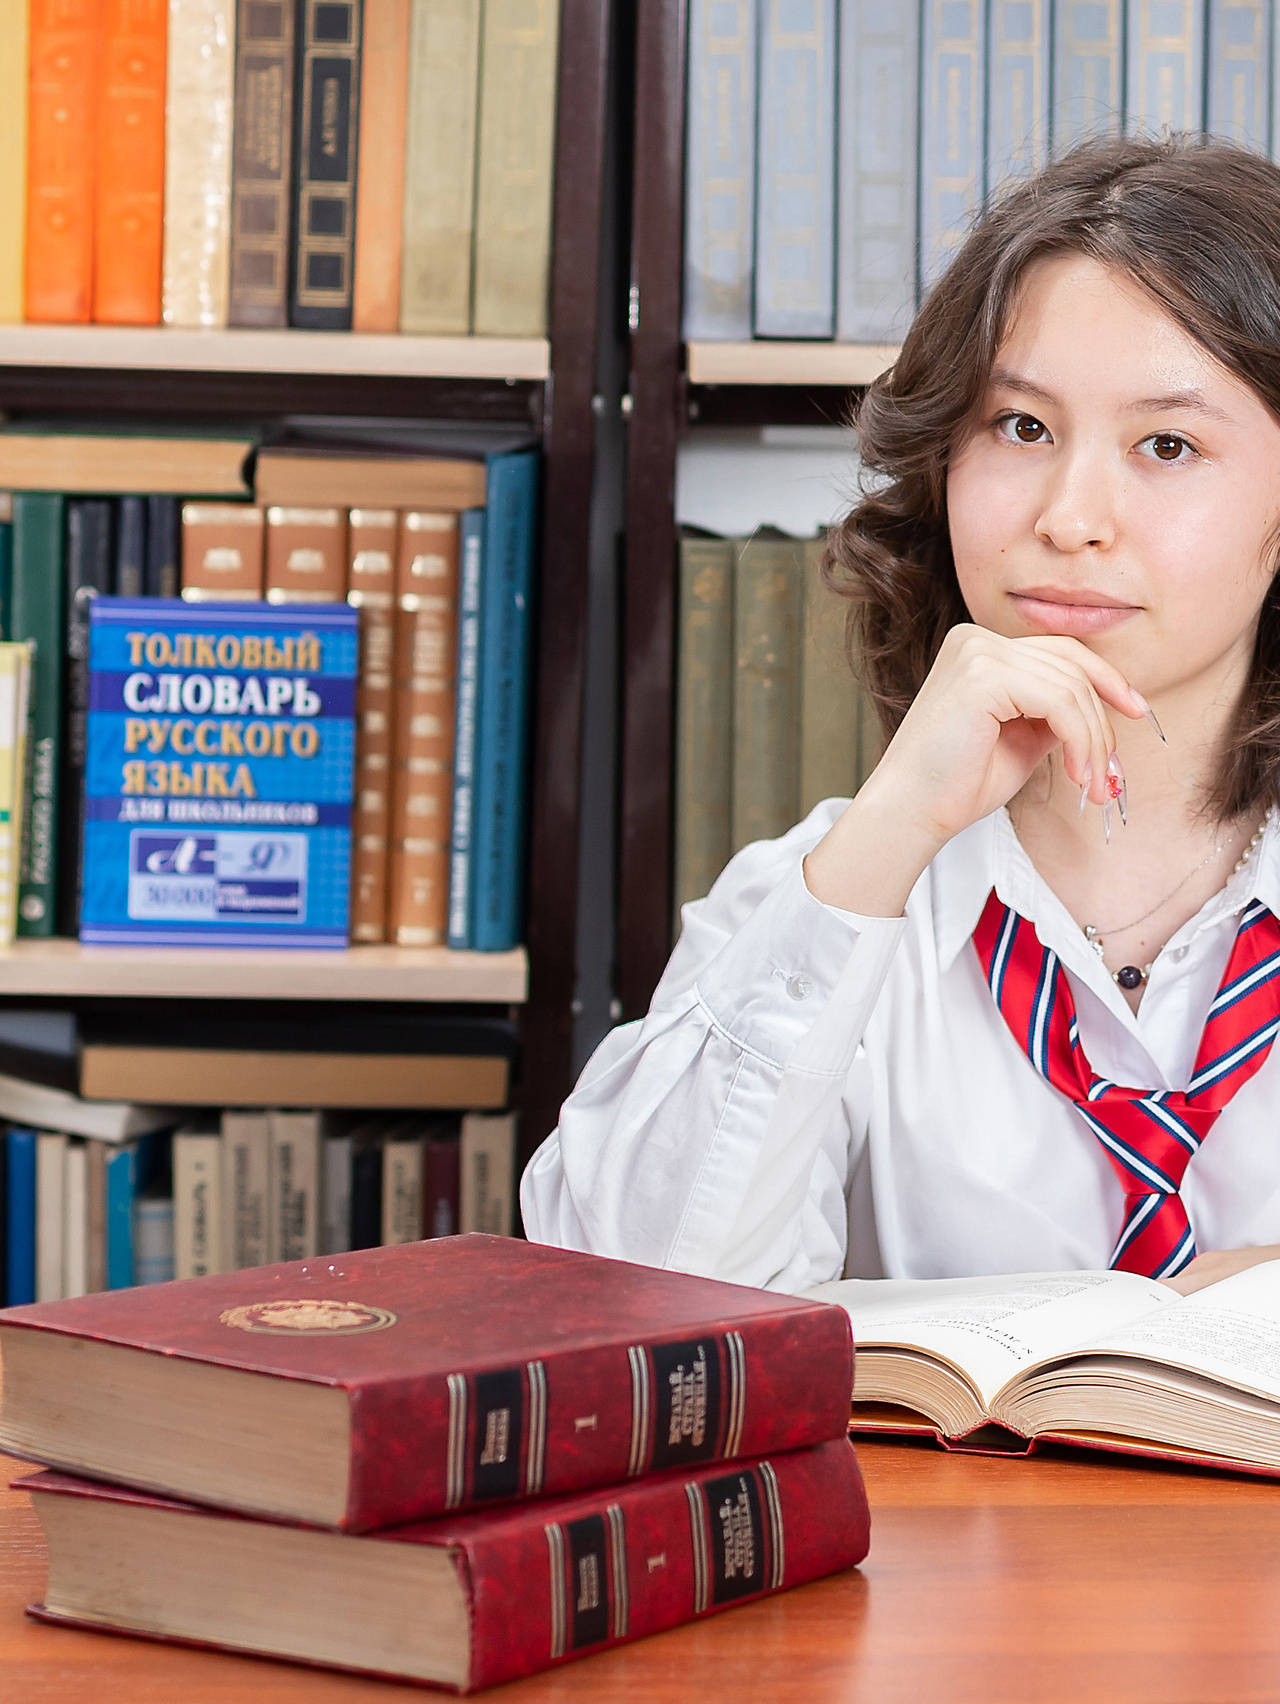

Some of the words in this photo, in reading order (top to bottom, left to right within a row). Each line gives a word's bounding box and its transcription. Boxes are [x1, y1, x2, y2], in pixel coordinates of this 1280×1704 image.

[125, 630, 322, 671] ТОЛКОВЫЙ
[122, 672, 322, 717] СЛОВАРЬ
[123, 717, 320, 758] РУССКОГО
[120, 759, 258, 798] ЯЗЫКА
[117, 797, 166, 823] ДЛЯ
[167, 799, 319, 826] ШКОЛЬНИКОВ
